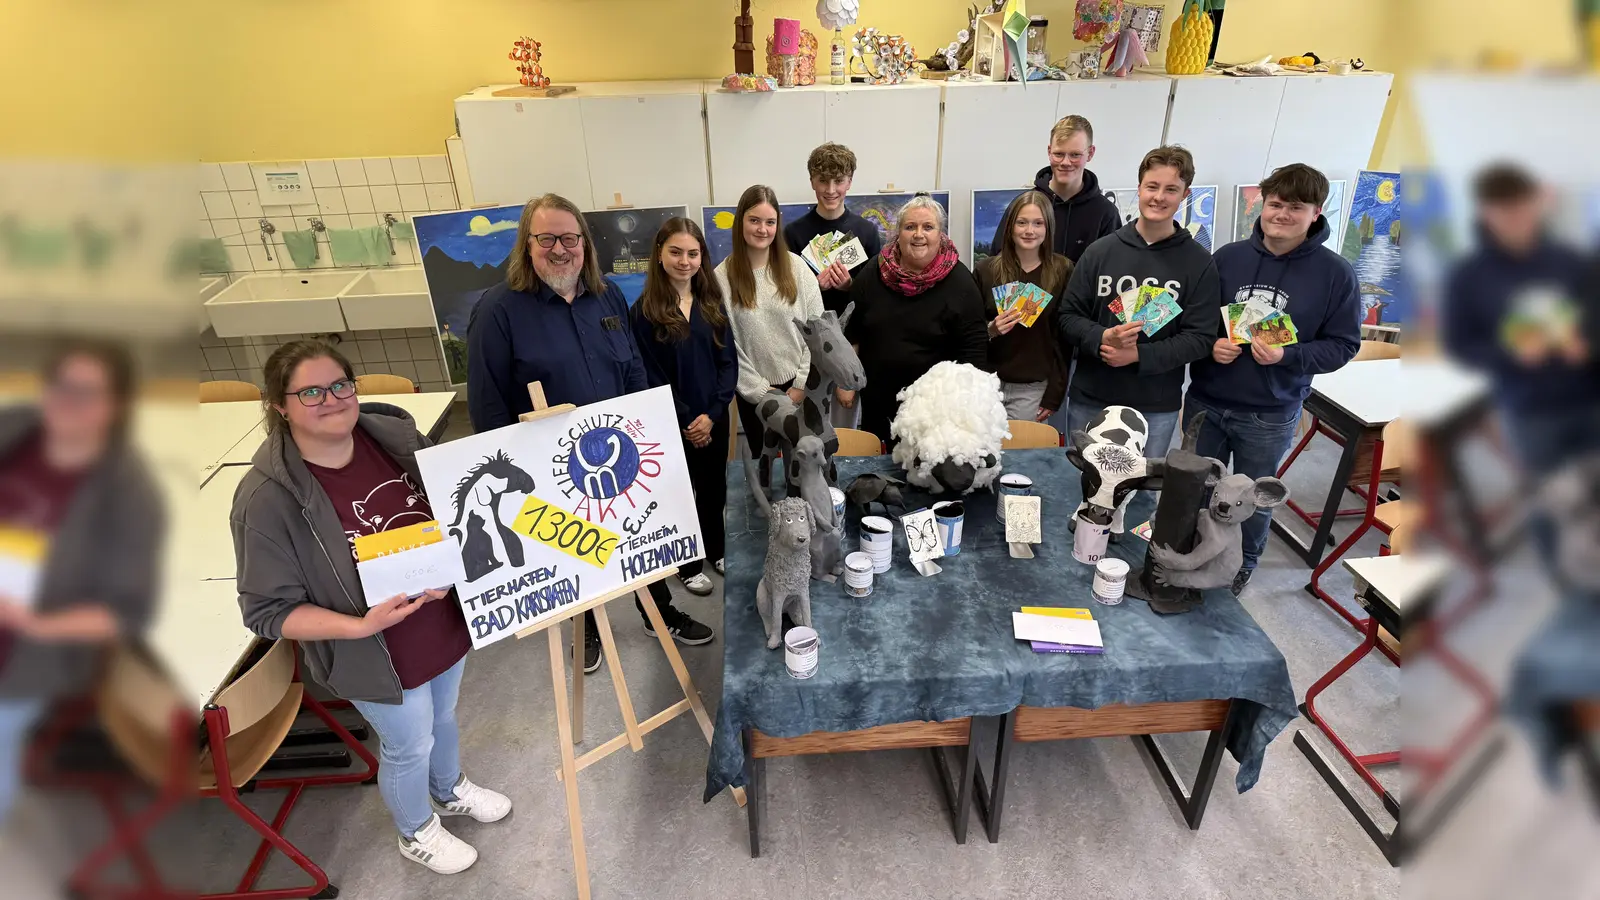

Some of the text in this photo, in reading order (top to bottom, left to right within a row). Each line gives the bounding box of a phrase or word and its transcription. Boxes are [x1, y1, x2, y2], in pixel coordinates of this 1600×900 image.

[1085, 59, 1096, 67] GIN
[552, 413, 624, 499] TIERSCHUTZ
[572, 442, 665, 523] AKTION
[524, 504, 621, 568] 1300€
[622, 501, 658, 535] Euro
[620, 534, 699, 582] HOLZMINDEN
[464, 565, 557, 611] TIERHAFEN
[471, 574, 580, 639] BAD KARLSHAFEN
